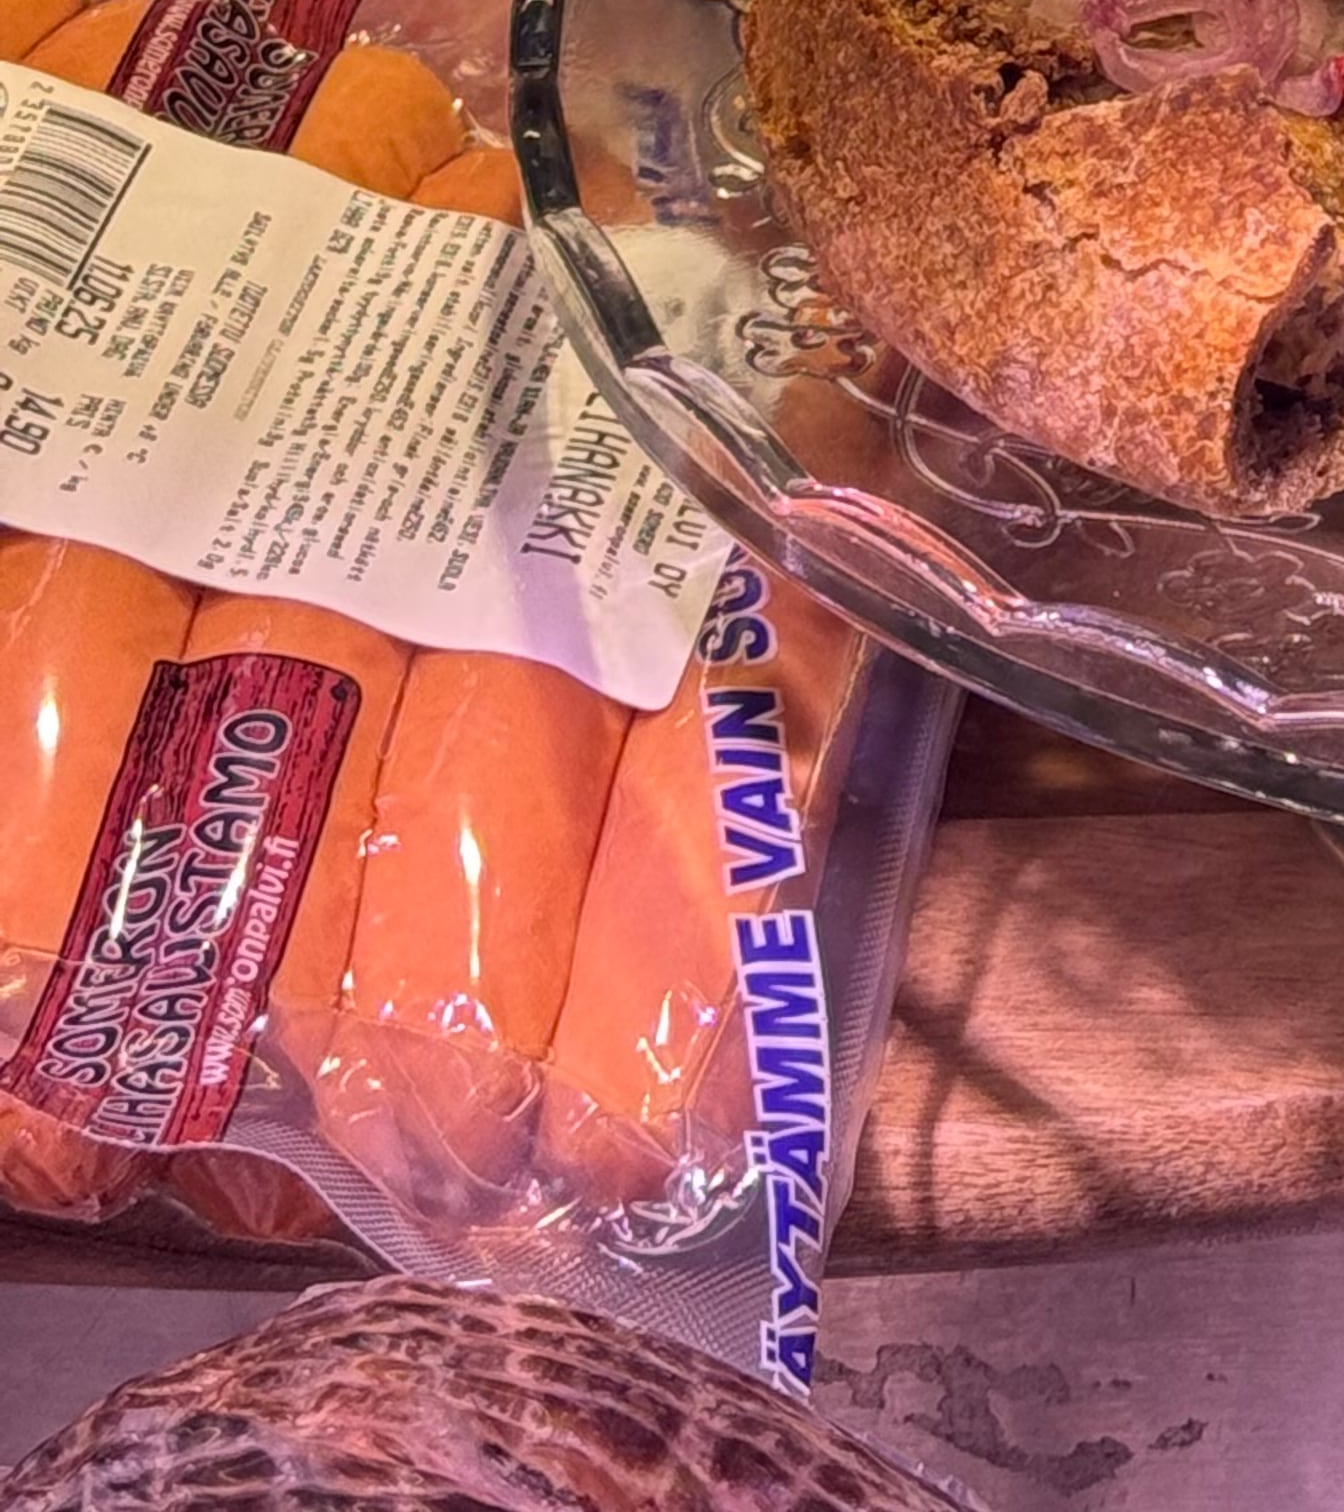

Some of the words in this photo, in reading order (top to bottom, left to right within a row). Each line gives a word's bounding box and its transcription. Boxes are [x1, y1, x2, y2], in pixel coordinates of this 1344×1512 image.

[122, 0, 196, 109] www.someronp
[212, 36, 318, 145] SOMER
[52, 250, 136, 350] 11.06.25
[0, 386, 63, 457] 14.90
[645, 560, 688, 600] OY
[695, 543, 777, 666] SU
[702, 687, 806, 892] VAIN
[738, 908, 830, 1398] ÄYTÄMME
